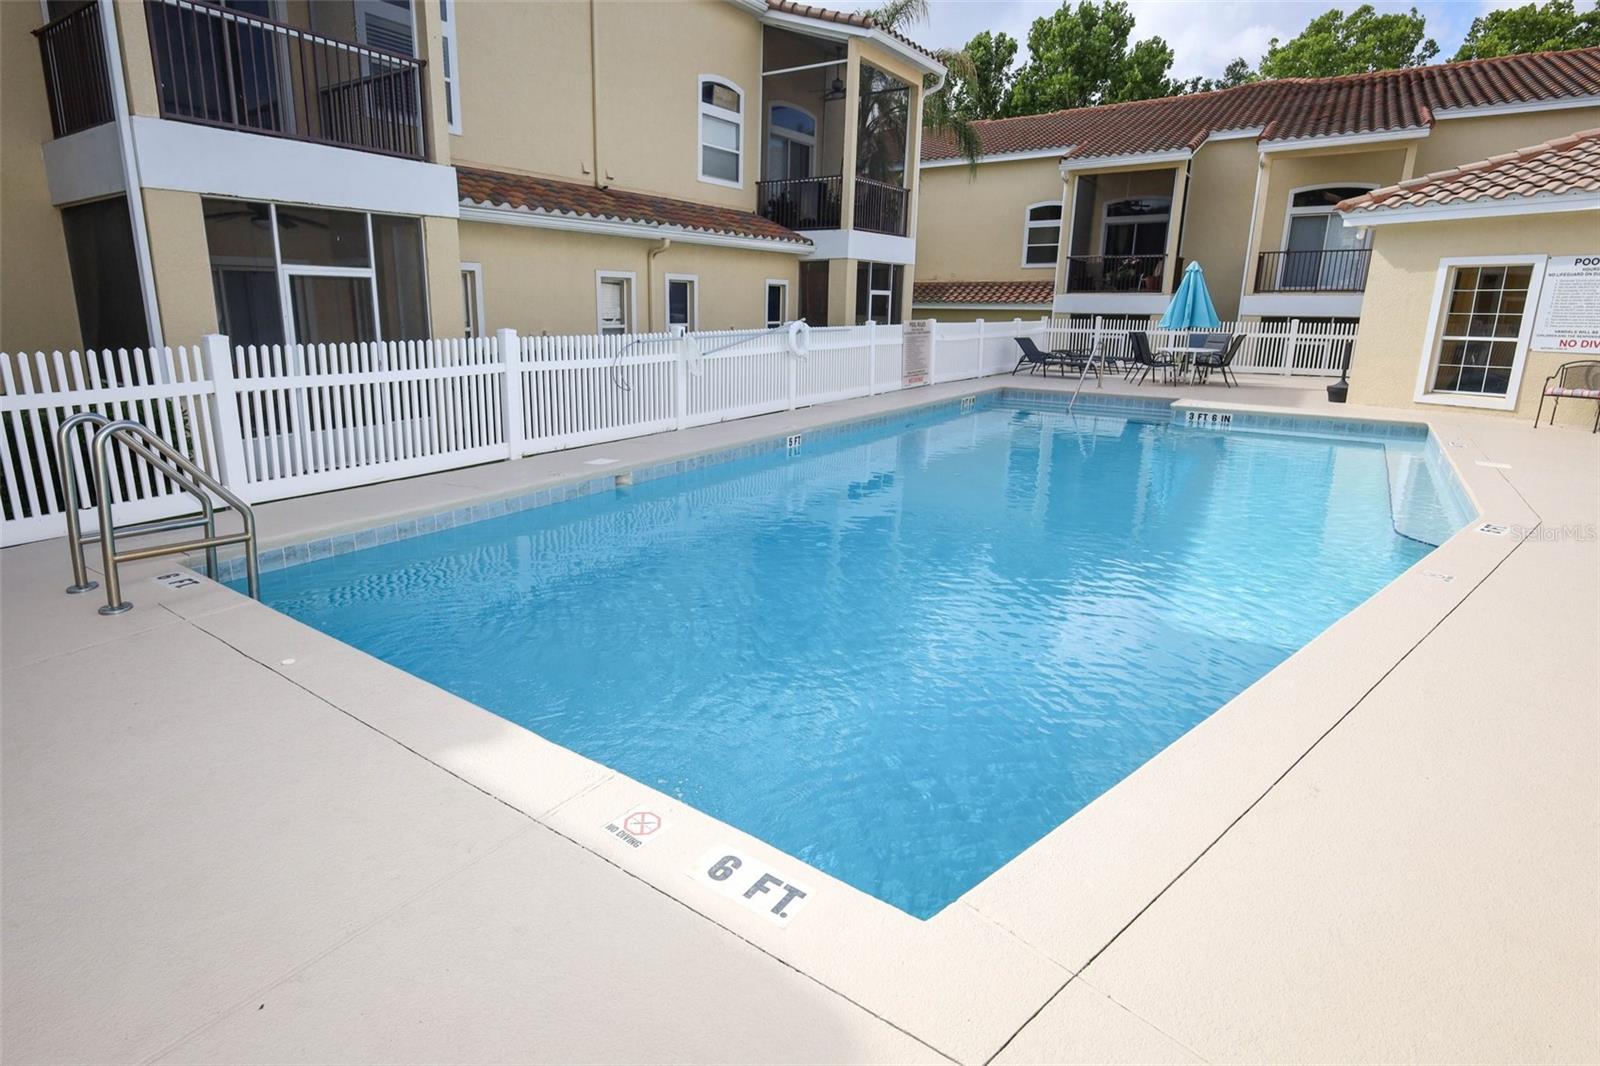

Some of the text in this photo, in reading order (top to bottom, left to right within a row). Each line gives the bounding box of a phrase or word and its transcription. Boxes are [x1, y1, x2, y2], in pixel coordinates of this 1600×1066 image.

[1559, 339, 1577, 348] NO
[1189, 412, 1195, 420] 3
[1198, 413, 1208, 421] FT
[789, 435, 801, 447] 5 FT
[605, 823, 642, 848] NO DIVING
[707, 855, 807, 918] 6 FT.
